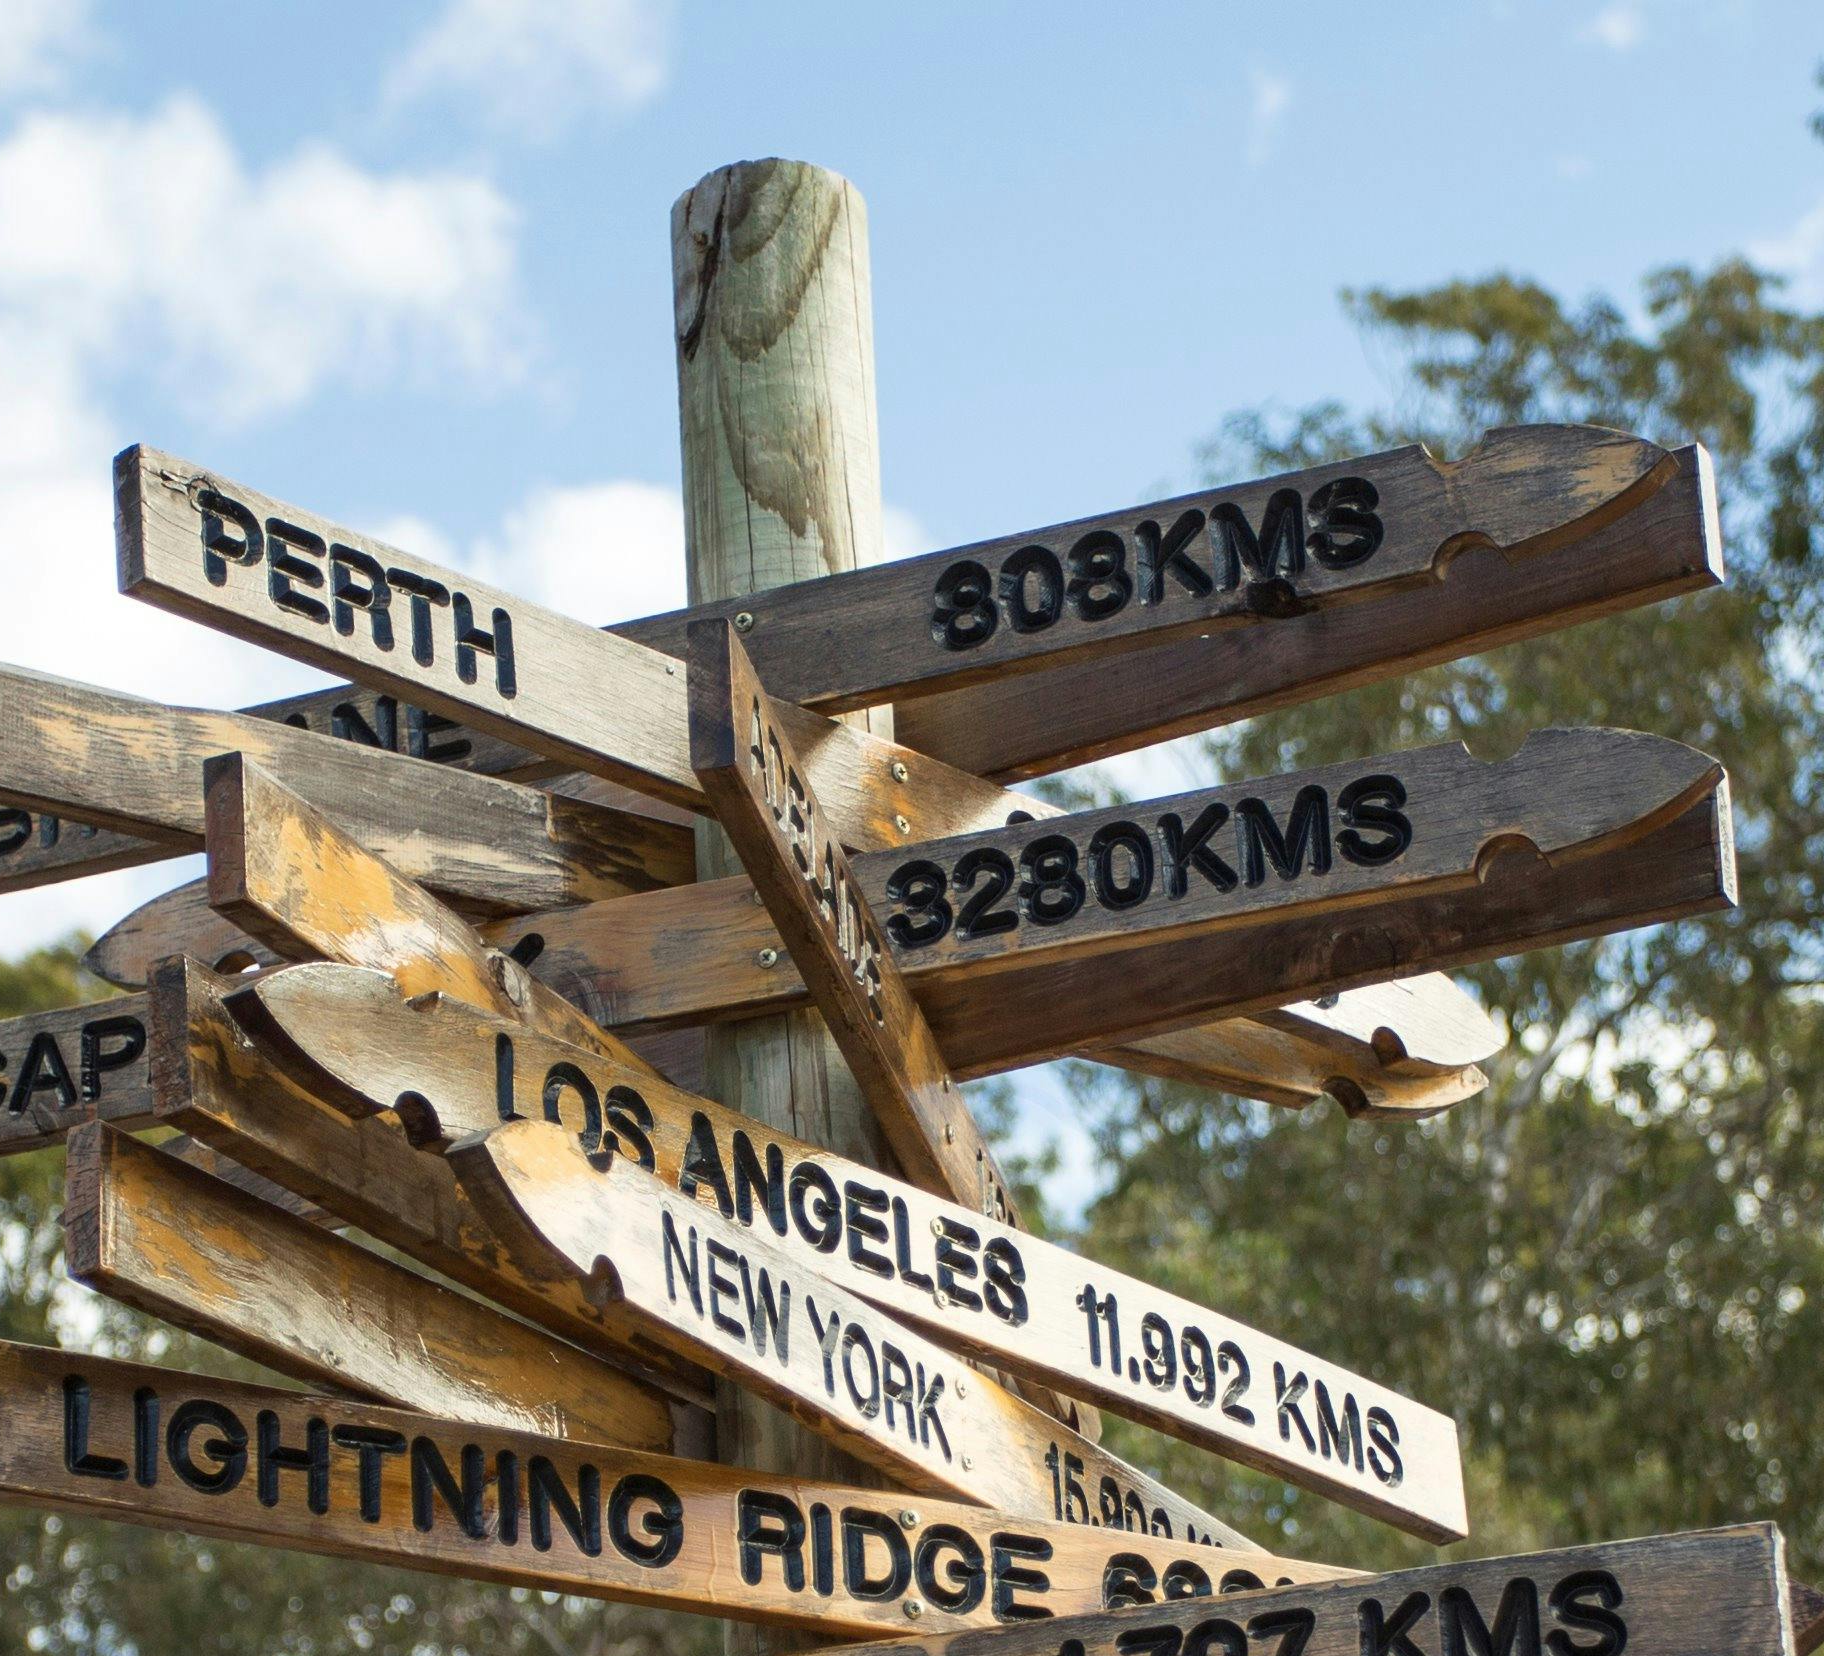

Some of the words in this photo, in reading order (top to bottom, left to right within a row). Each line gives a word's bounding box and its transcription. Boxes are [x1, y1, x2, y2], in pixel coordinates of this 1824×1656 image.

[199, 488, 517, 700] PERTH
[931, 476, 1385, 651] 808KMS
[751, 695, 884, 1028] ADELAIDE
[884, 773, 1413, 950] 3280KMS
[495, 1032, 656, 1175] LOS
[678, 1111, 1027, 1326] ANGELES
[1075, 1282, 1253, 1428] 11.992
[1274, 1360, 1405, 1489] KMS
[660, 1209, 791, 1365] NEW
[805, 1294, 953, 1464] YORK
[62, 1373, 685, 1568] LIGHTNING
[737, 1488, 1054, 1623] RIDGE
